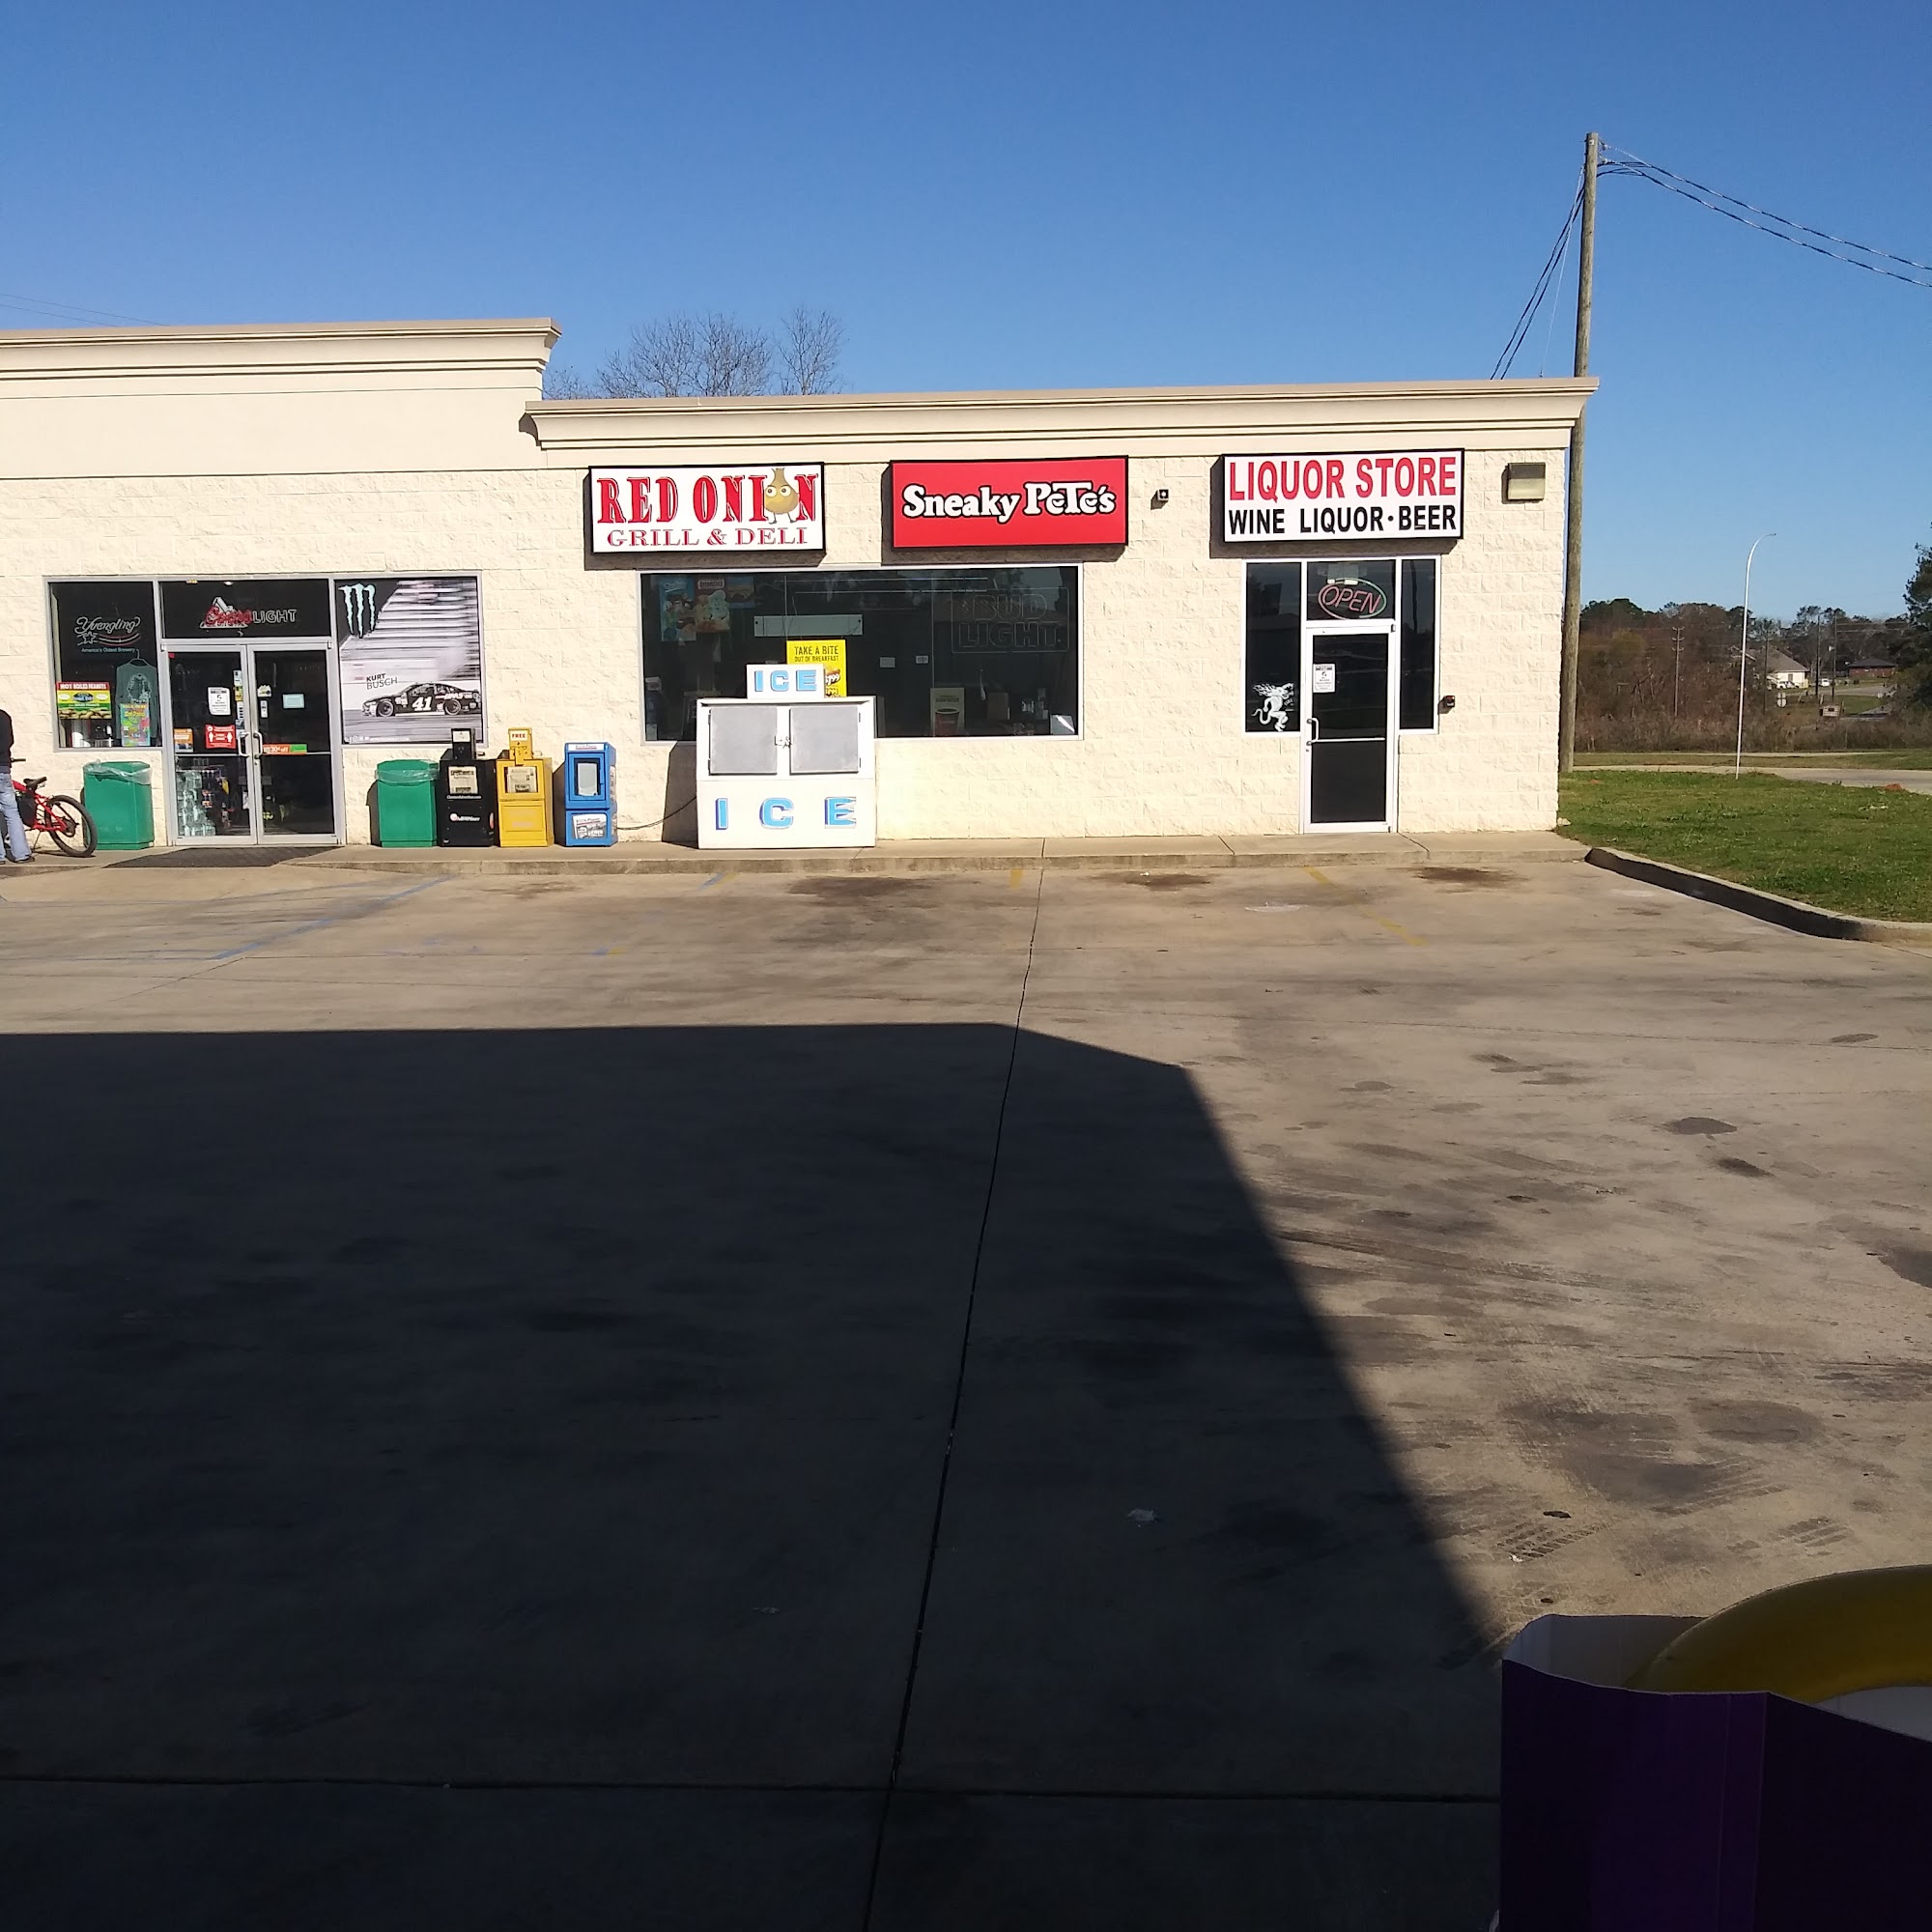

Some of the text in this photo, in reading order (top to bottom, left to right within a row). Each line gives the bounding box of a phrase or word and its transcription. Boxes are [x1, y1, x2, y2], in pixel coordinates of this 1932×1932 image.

[1229, 457, 1457, 503] LIQUOR STORE
[597, 476, 678, 524] RED
[902, 483, 1021, 525] Sneaky
[1229, 504, 1457, 535] WINE LIQUOR BEER
[607, 526, 808, 547] GRILL & DELI
[973, 593, 1048, 620] BUD
[1321, 585, 1382, 614] OPEN
[74, 616, 141, 634] Yuengling
[252, 609, 297, 624] LIGHT
[958, 620, 1061, 648] LIGHT
[794, 645, 839, 655] TAKE A BITE
[366, 673, 386, 682] KURT
[367, 677, 398, 690] BUSCH
[754, 669, 816, 692] ICE
[412, 696, 433, 712] 41
[715, 796, 857, 831] ICE
